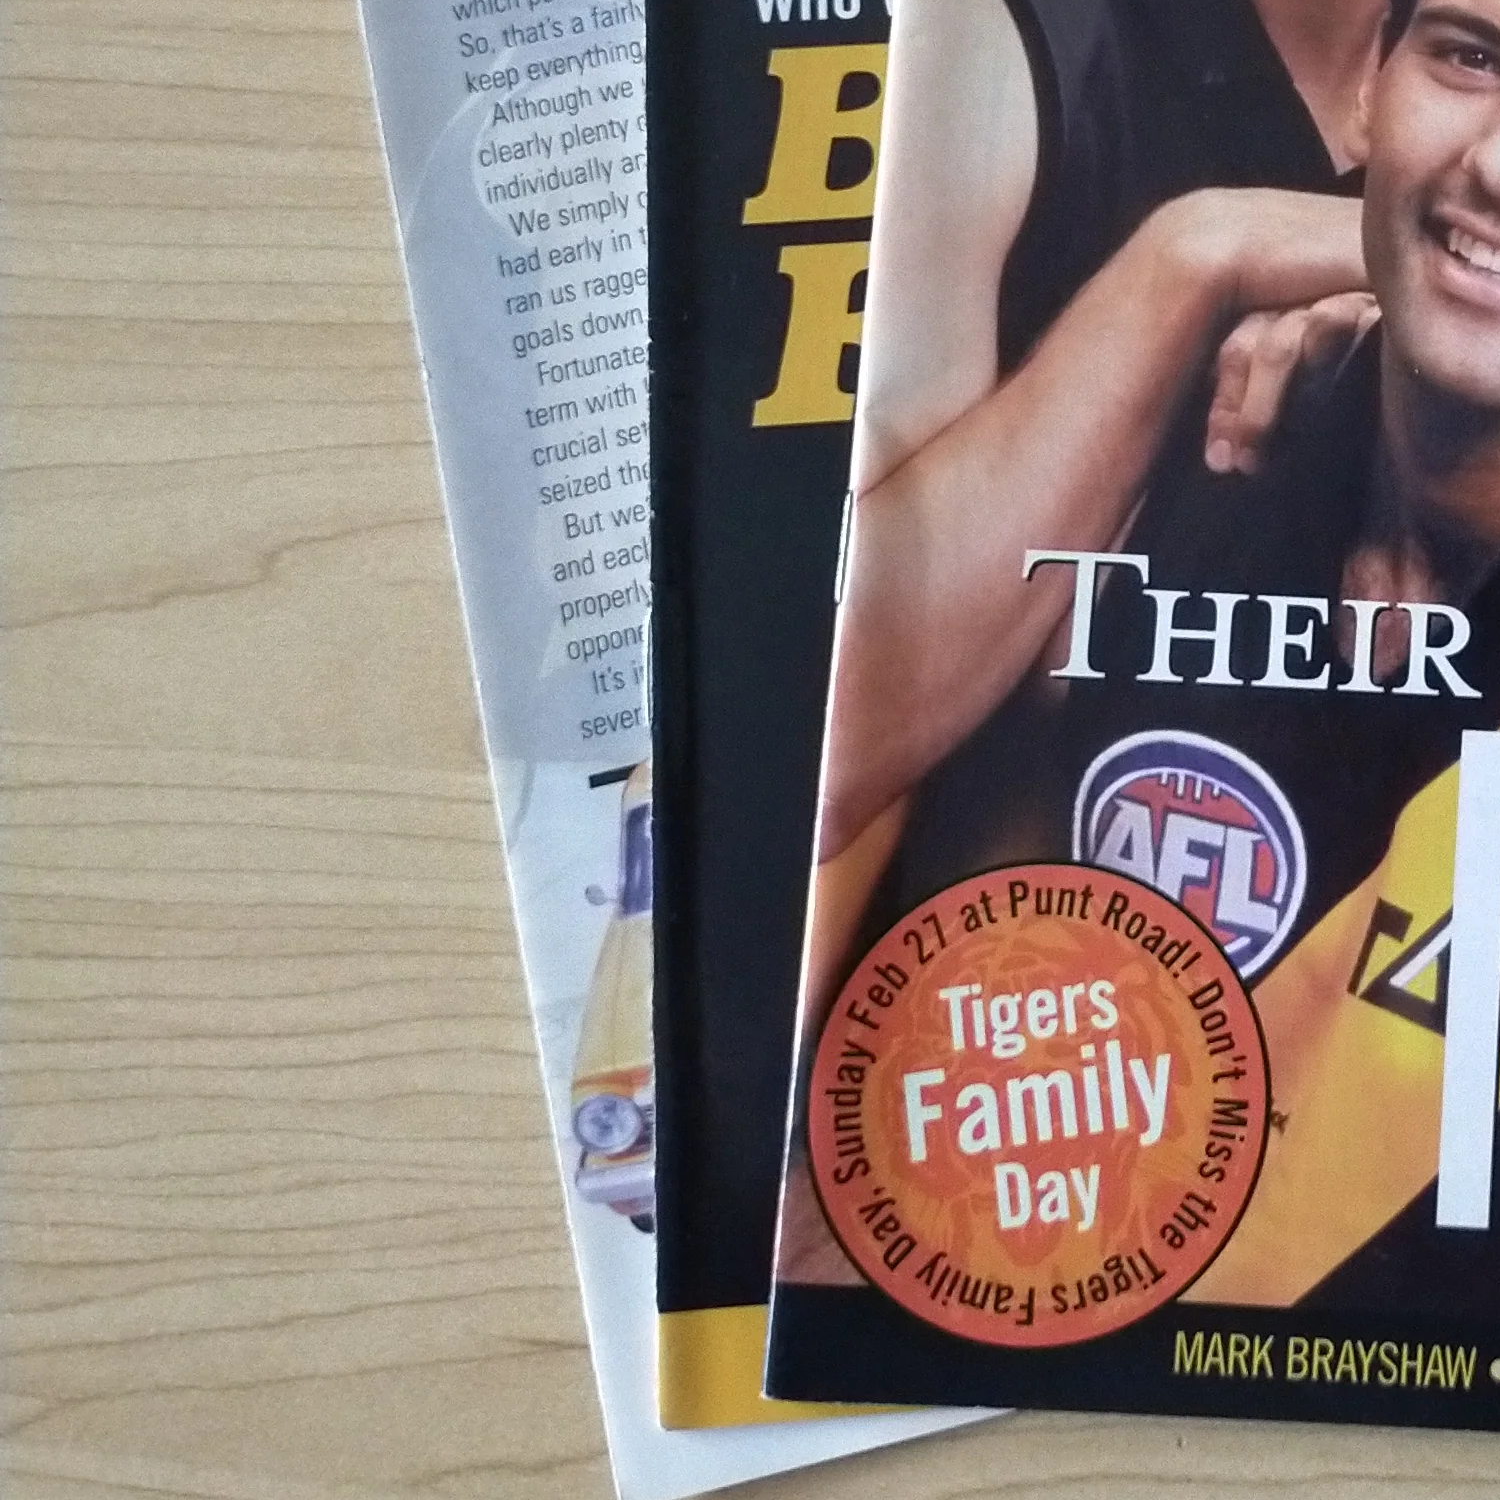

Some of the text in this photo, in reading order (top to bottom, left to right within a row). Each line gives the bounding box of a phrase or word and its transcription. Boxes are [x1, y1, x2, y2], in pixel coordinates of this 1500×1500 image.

[504, 16, 564, 51] that's
[572, 15, 585, 35] a
[465, 64, 520, 94] keep
[492, 79, 634, 127] Although we
[479, 132, 553, 169] clearly
[561, 117, 629, 155] plenty
[485, 156, 613, 203] individually
[509, 210, 550, 237] We
[558, 190, 629, 227] simply
[500, 247, 541, 277] had
[549, 235, 603, 268] early
[611, 228, 632, 253] in
[506, 292, 542, 316] ran
[551, 283, 576, 306] us
[513, 307, 644, 358] goals down
[526, 399, 579, 428] term
[586, 382, 637, 414] with
[532, 426, 608, 467] crucial
[540, 465, 611, 505] seized
[564, 510, 605, 539] But
[553, 549, 595, 582] and
[593, 666, 625, 695] It's
[1094, 797, 1280, 934] AFL
[962, 890, 999, 933] at
[1008, 879, 1095, 921] Punt
[903, 913, 948, 965] 27
[1101, 889, 1202, 982] Road!
[851, 960, 911, 1031] Feb
[939, 978, 1119, 1060] Tigers
[1188, 978, 1249, 1084] Don't
[825, 1042, 877, 1186] Sunday
[902, 1039, 1172, 1165] Family
[1198, 1096, 1250, 1184] Miss
[994, 1161, 1101, 1235] Day
[1159, 1190, 1218, 1251] the
[916, 1250, 1036, 1327] Family
[1051, 1248, 1167, 1316] Tigers
[1173, 1329, 1275, 1380] MARK
[1286, 1336, 1477, 1392] BRAYSHAW
